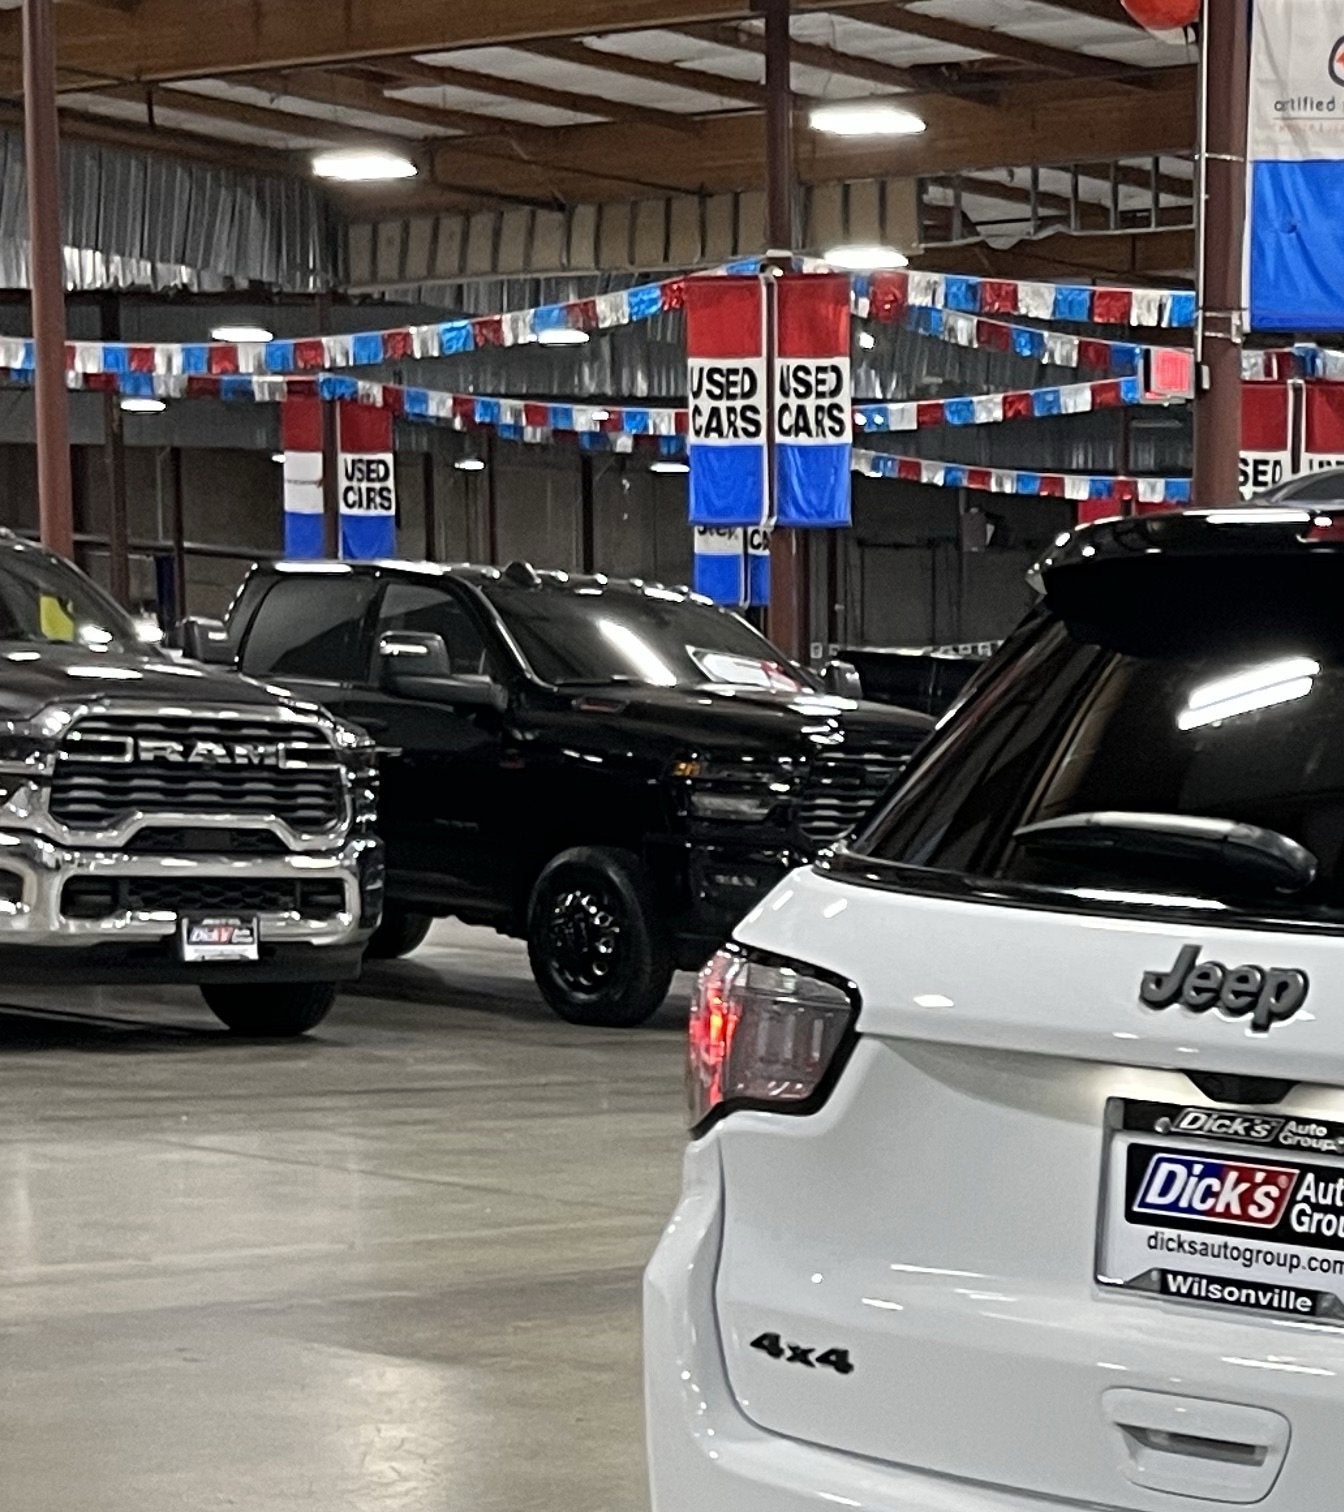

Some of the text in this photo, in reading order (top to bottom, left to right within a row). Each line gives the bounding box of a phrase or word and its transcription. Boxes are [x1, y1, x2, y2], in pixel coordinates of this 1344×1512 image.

[691, 366, 758, 401] USED
[779, 364, 844, 400] USED
[692, 403, 762, 439] CARS
[777, 402, 846, 439] CARS
[343, 458, 390, 483] USED
[1239, 458, 1284, 487] SED
[137, 739, 279, 765] RAM
[1138, 944, 1309, 1032] Jeep
[1180, 1111, 1272, 1138] Dick's
[1284, 1120, 1328, 1137] Auto
[1145, 1161, 1280, 1218] Dick's
[1165, 1272, 1313, 1313] Wilsonville
